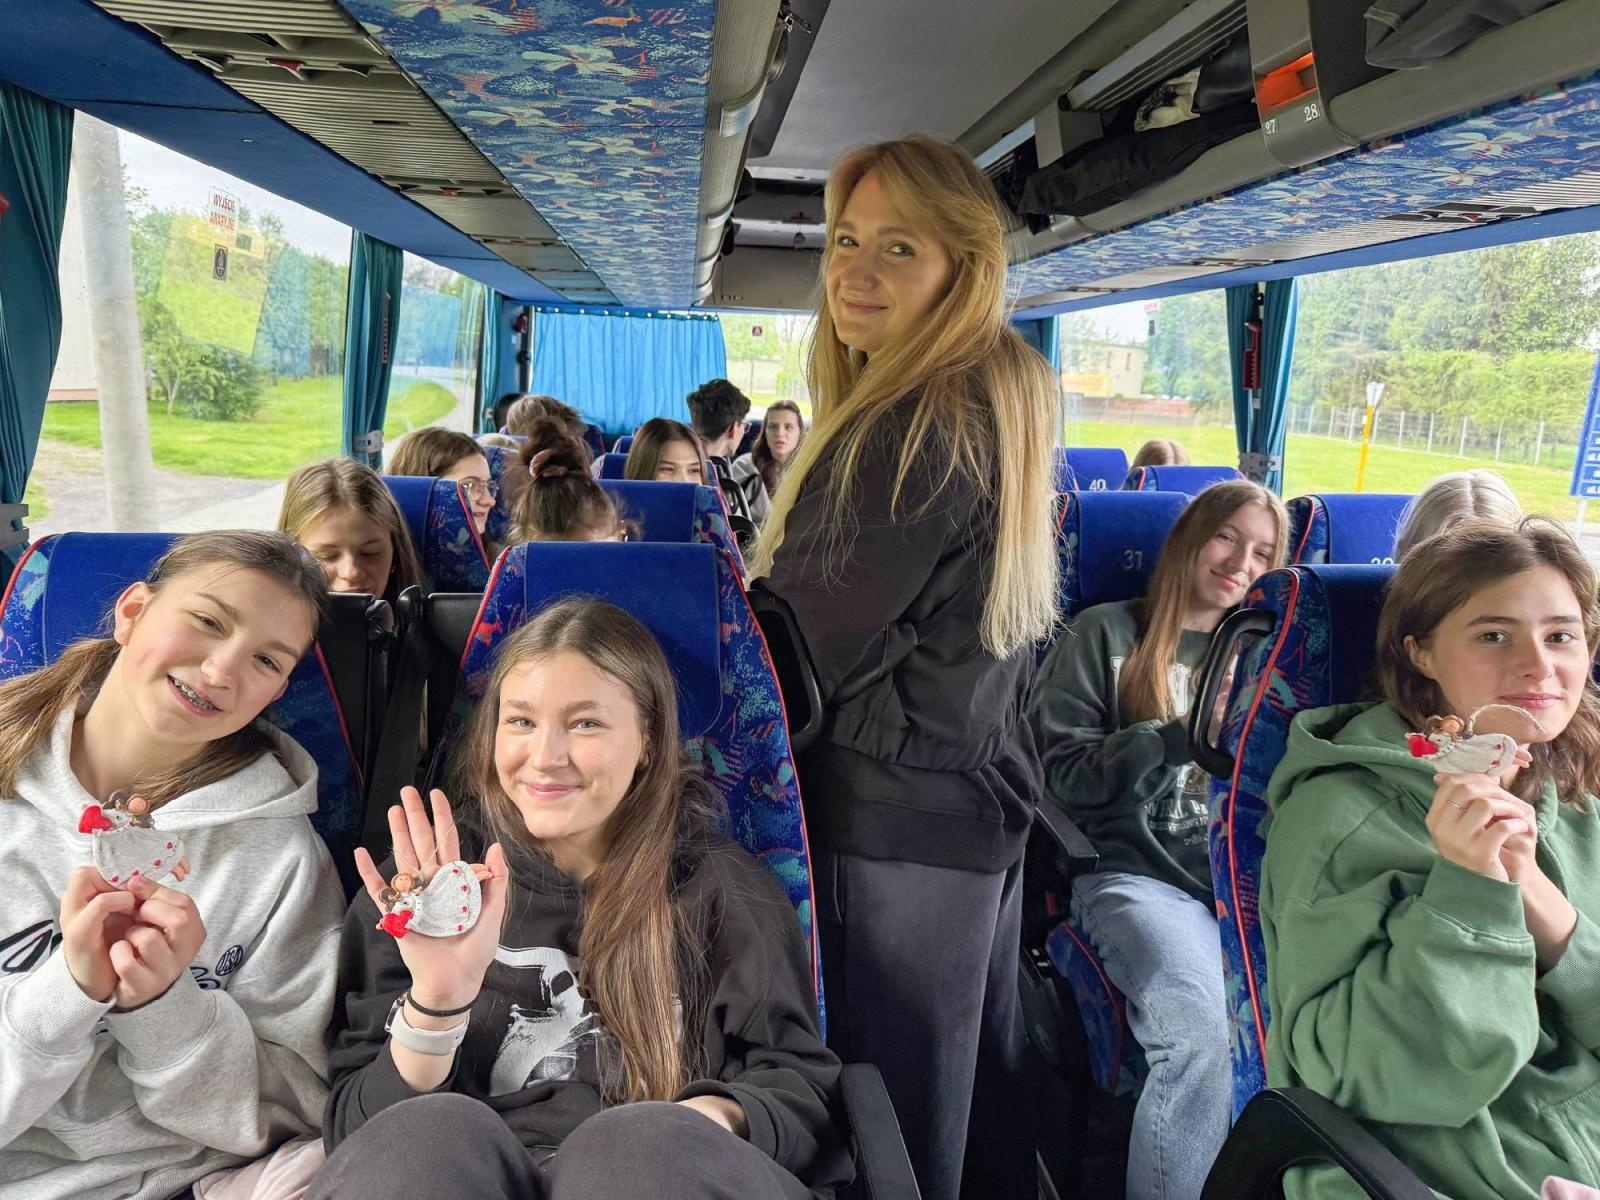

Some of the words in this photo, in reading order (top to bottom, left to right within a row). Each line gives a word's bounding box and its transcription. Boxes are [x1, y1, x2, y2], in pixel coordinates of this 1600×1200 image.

[1264, 117, 1276, 134] 27
[1304, 103, 1318, 122] 28
[213, 191, 235, 213] WYJŚCIE
